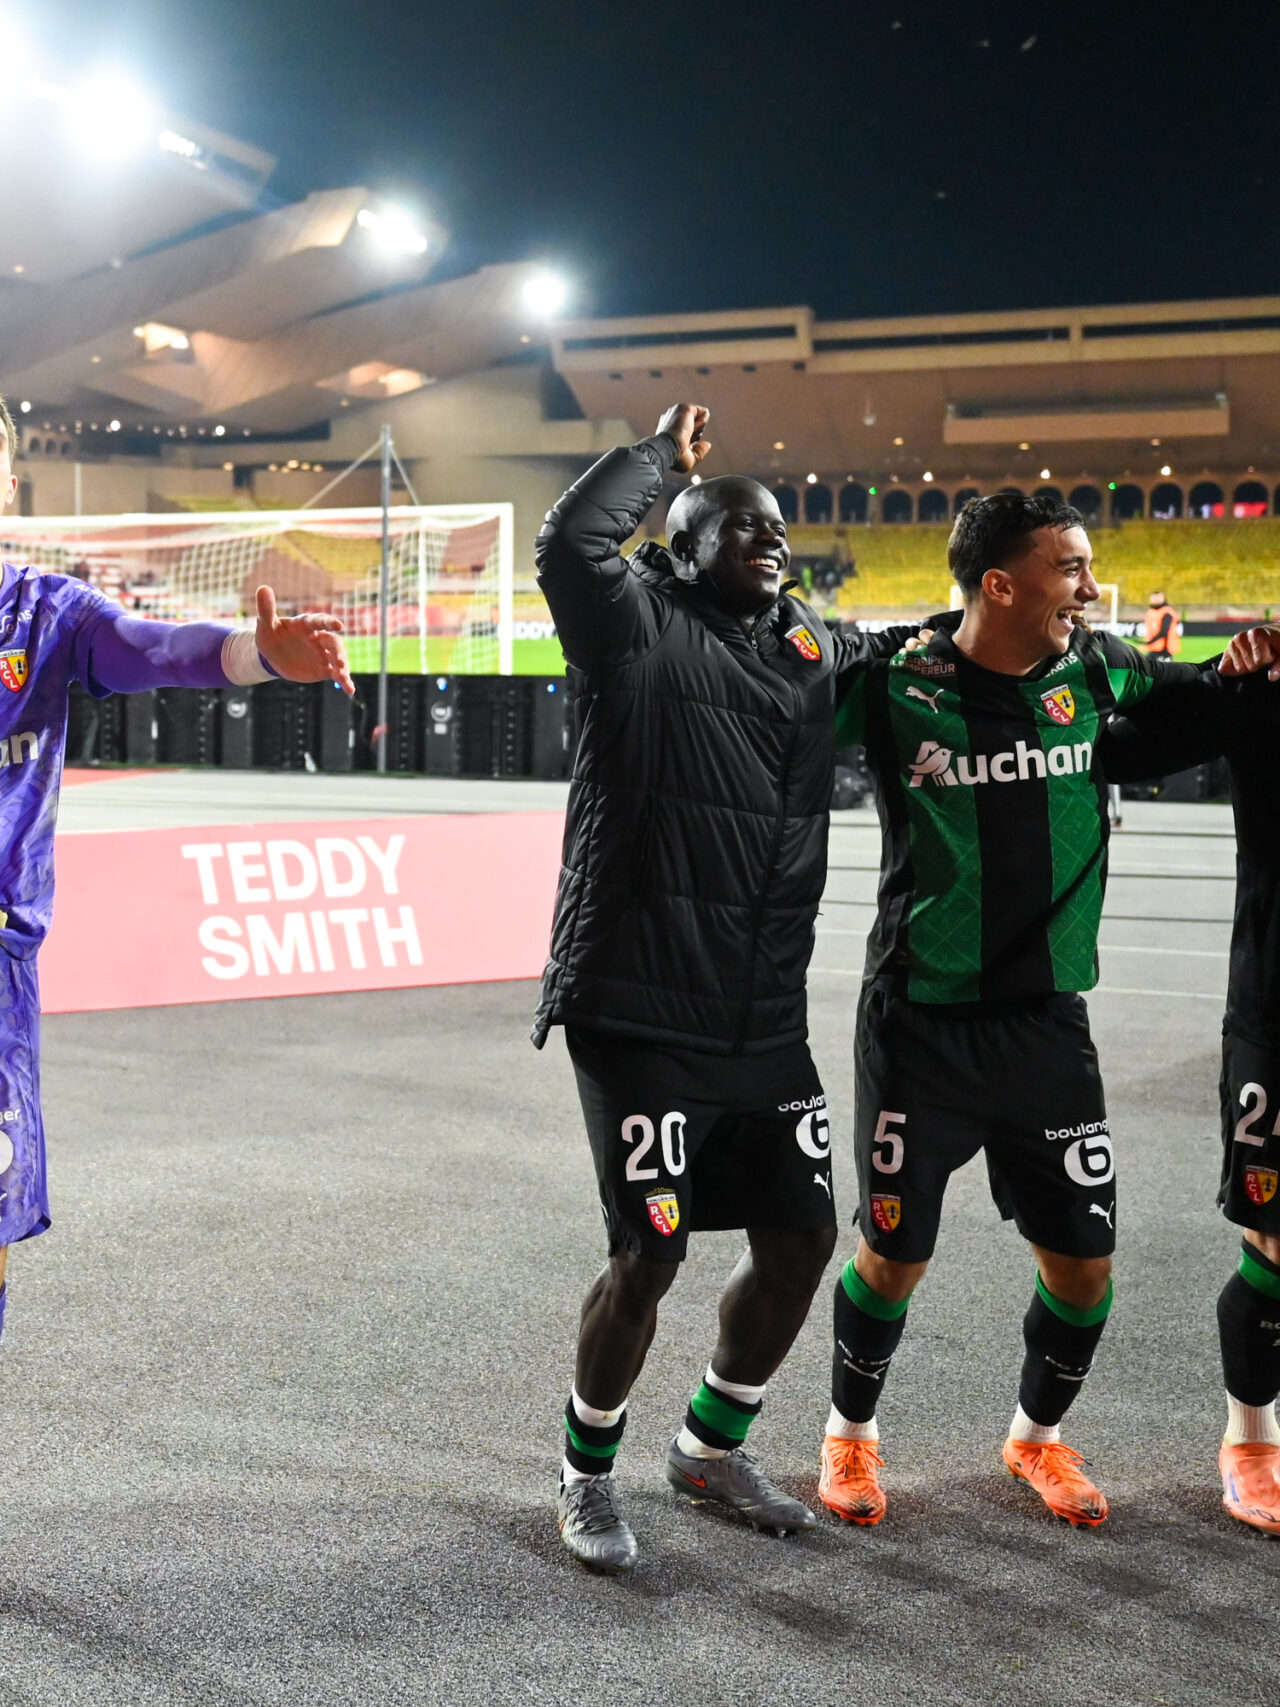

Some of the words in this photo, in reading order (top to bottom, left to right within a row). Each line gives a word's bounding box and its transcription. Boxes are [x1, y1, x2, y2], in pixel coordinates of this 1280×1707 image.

[908, 740, 1093, 788] Auchan
[181, 834, 406, 905] TEDDY
[198, 905, 424, 980] SMITH
[621, 1111, 687, 1182] 20
[872, 1110, 907, 1175] 5
[1234, 1082, 1280, 1147] 2
